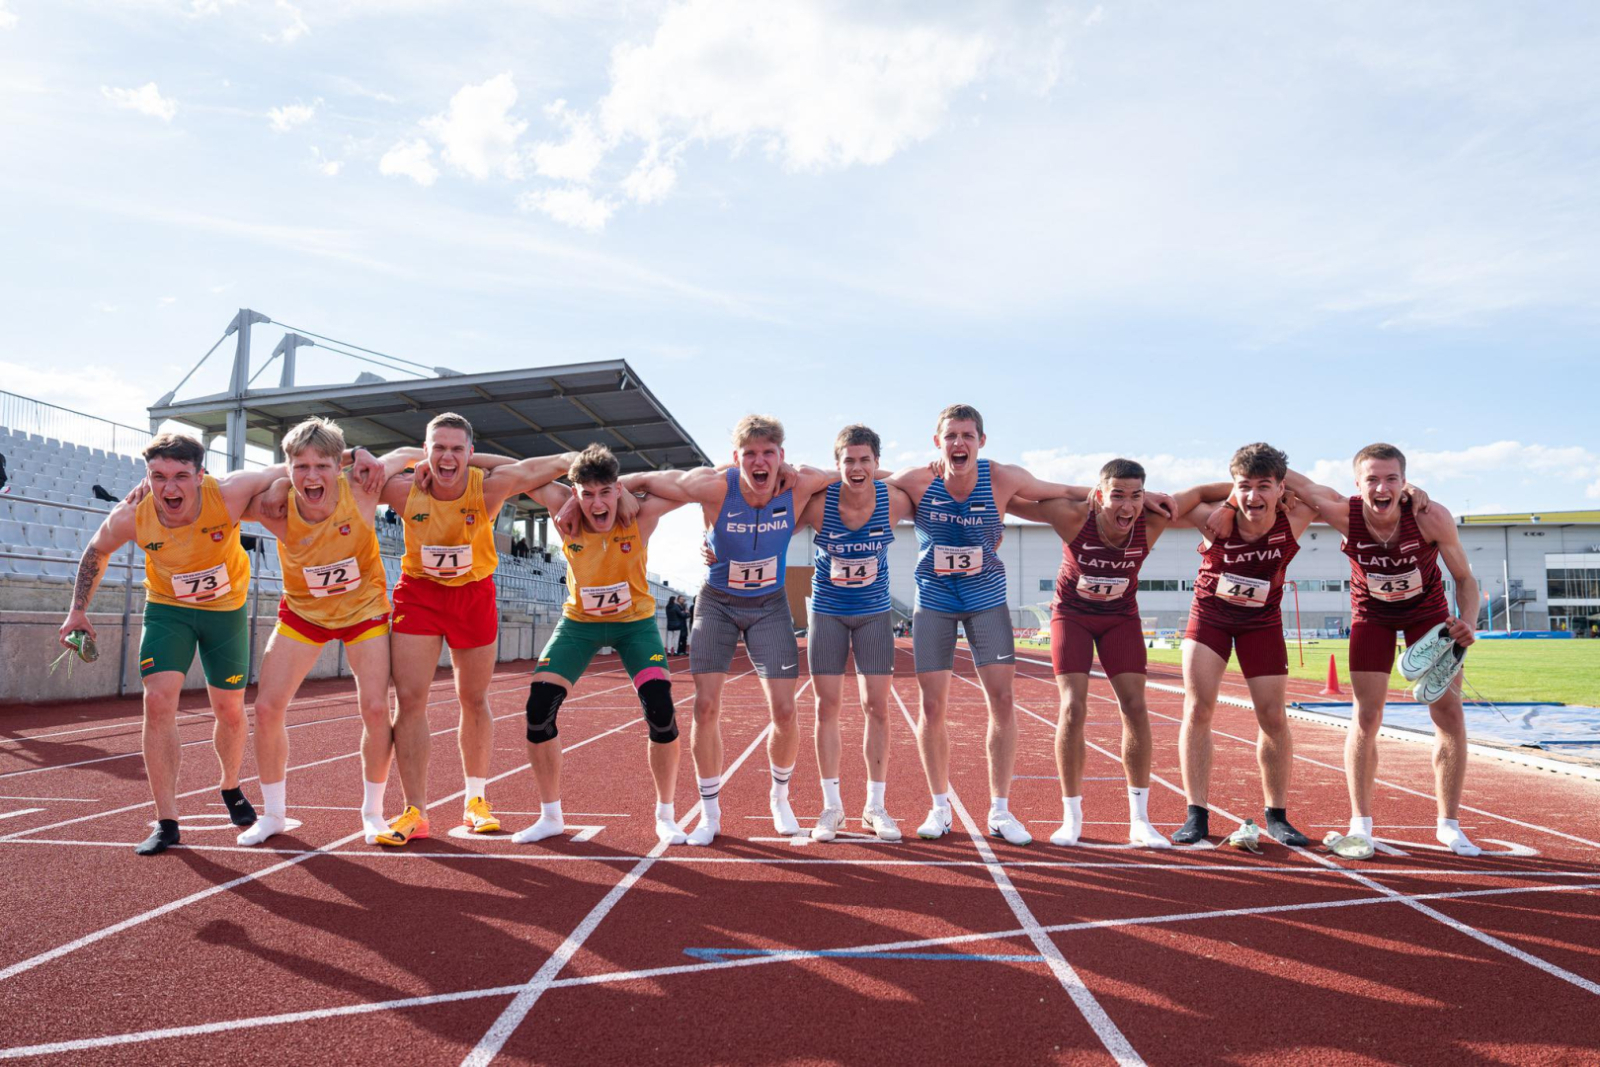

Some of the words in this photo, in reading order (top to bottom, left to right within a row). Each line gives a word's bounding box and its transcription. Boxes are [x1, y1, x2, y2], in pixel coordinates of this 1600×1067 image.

[411, 513, 430, 522] 4F
[929, 511, 983, 526] ESTONIA
[726, 519, 789, 533] ESTONIA
[144, 542, 164, 551] 4F
[568, 543, 584, 552] 4F
[827, 540, 883, 553] ESTONIA
[432, 553, 458, 567] 71
[945, 554, 971, 569] 13
[1077, 554, 1136, 568] LATVIA
[1223, 548, 1282, 563] LATVIA
[1357, 554, 1418, 567] LATVIA
[317, 568, 349, 586] 72
[741, 567, 764, 580] 11
[841, 565, 866, 579] 14
[185, 576, 218, 593] 73
[1087, 584, 1113, 595] 41
[1227, 584, 1255, 598] 44
[1380, 580, 1410, 592] 43
[592, 592, 620, 608] 74
[225, 674, 244, 684] 4F
